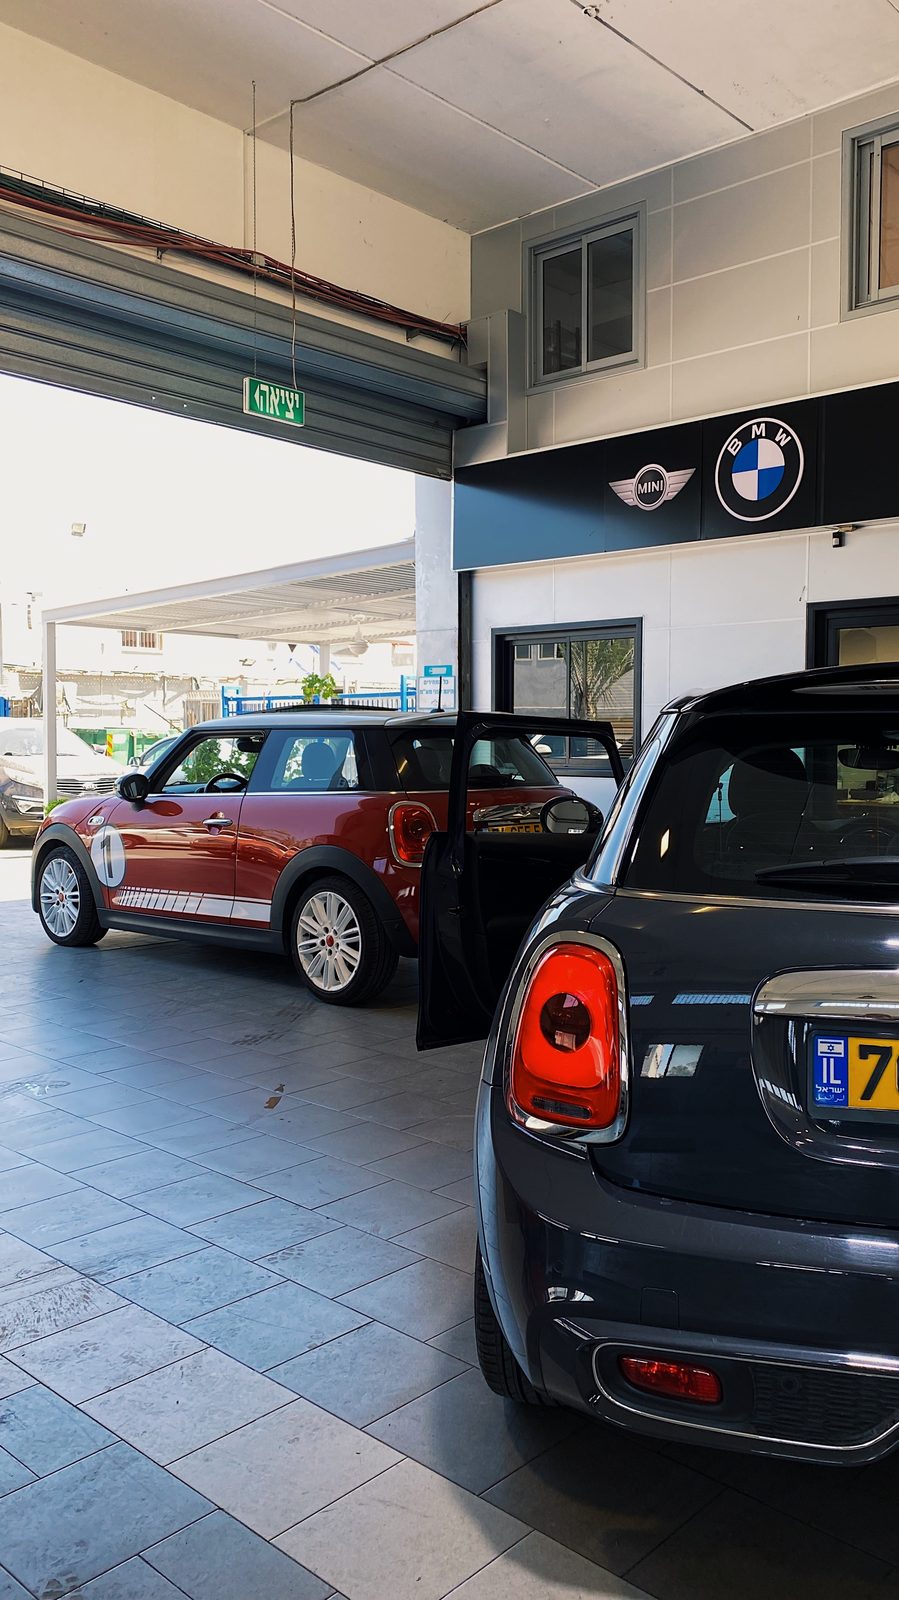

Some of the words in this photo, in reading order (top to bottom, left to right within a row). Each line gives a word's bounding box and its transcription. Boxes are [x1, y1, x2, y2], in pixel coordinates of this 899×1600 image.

[260, 384, 299, 419] יציאה
[727, 422, 792, 456] BMW
[637, 480, 664, 495] MINI
[100, 835, 114, 879] 1
[822, 1057, 841, 1085] IL
[859, 1044, 899, 1101] 7
[815, 1084, 845, 1094] ישראל
